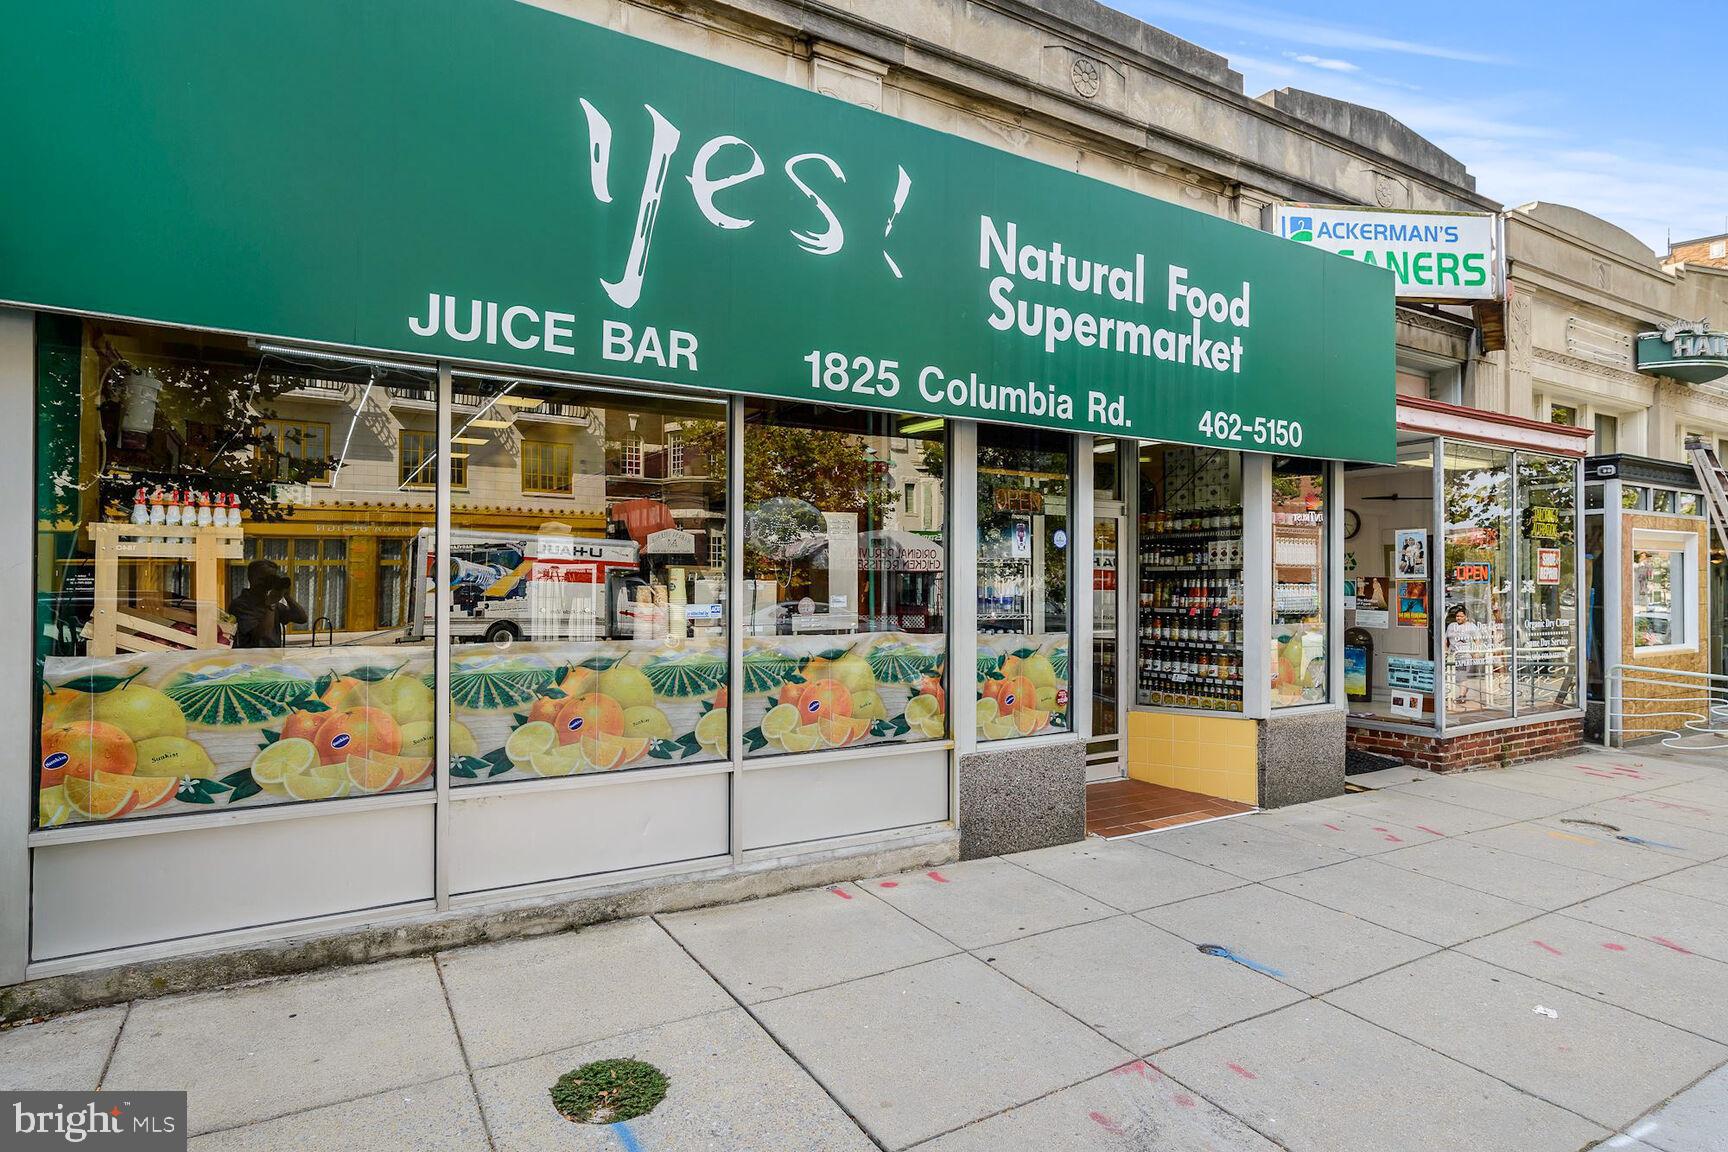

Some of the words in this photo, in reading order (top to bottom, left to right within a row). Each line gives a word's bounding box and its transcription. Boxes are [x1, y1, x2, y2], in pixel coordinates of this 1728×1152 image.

[1317, 222, 1459, 242] ACKERMAN'S
[979, 214, 1146, 305] Natural
[1167, 264, 1250, 328] Food
[408, 293, 575, 355] JUICE
[602, 319, 698, 371] BAR
[987, 276, 1244, 374] Supermarket
[1672, 335, 1728, 357] HAI
[804, 350, 900, 397] 1825
[918, 365, 1073, 420] Columbia
[1088, 390, 1132, 427] Rd.
[1198, 410, 1303, 448] 462-5150
[1455, 565, 1489, 581] OPEN
